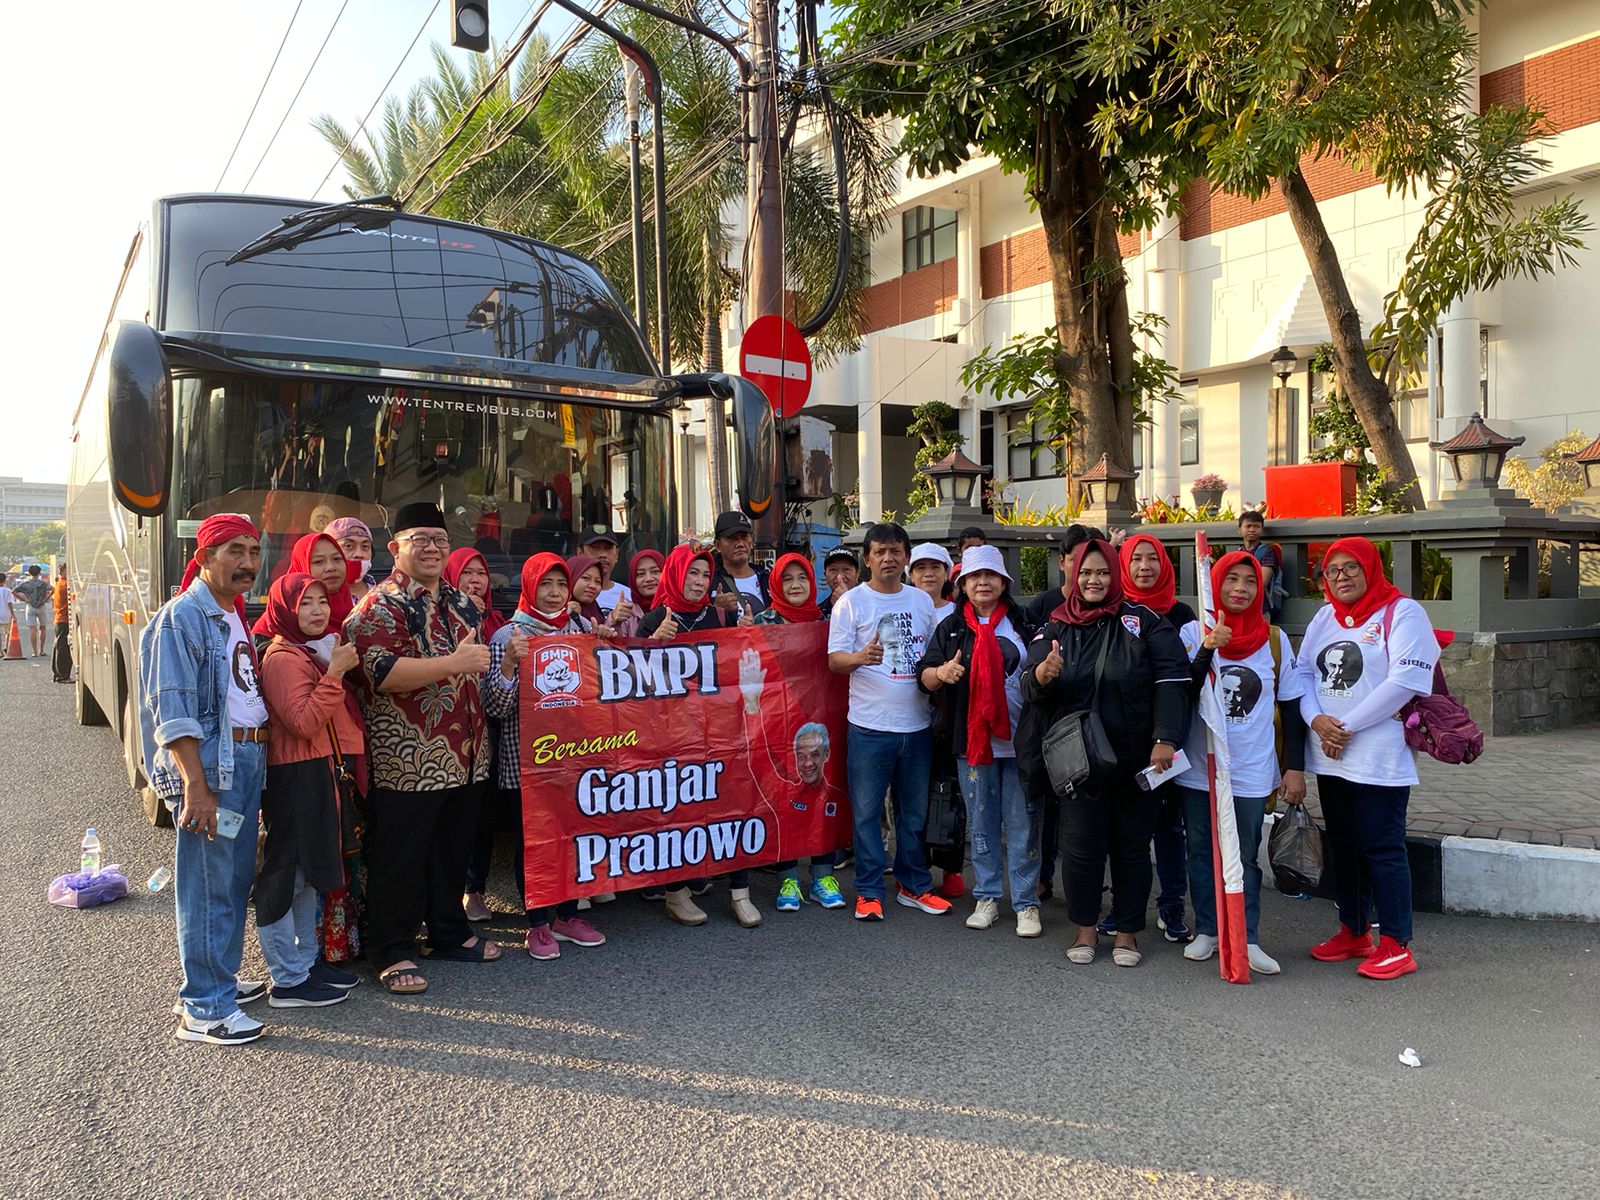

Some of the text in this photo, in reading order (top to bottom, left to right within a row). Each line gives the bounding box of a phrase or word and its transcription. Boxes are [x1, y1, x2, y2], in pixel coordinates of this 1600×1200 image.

[367, 394, 557, 420] WWW.TENTREMBUS.COM
[541, 649, 574, 662] BMPI
[1399, 659, 1432, 671] SIBER
[596, 643, 719, 701] BMPI
[1318, 688, 1353, 699] SIBER
[246, 696, 264, 707] SIB
[542, 700, 576, 708] INDONESIA
[1226, 716, 1252, 725] BER
[532, 729, 640, 765] Bersama
[576, 759, 724, 817] Ganjar
[575, 816, 767, 883] Pranowo
